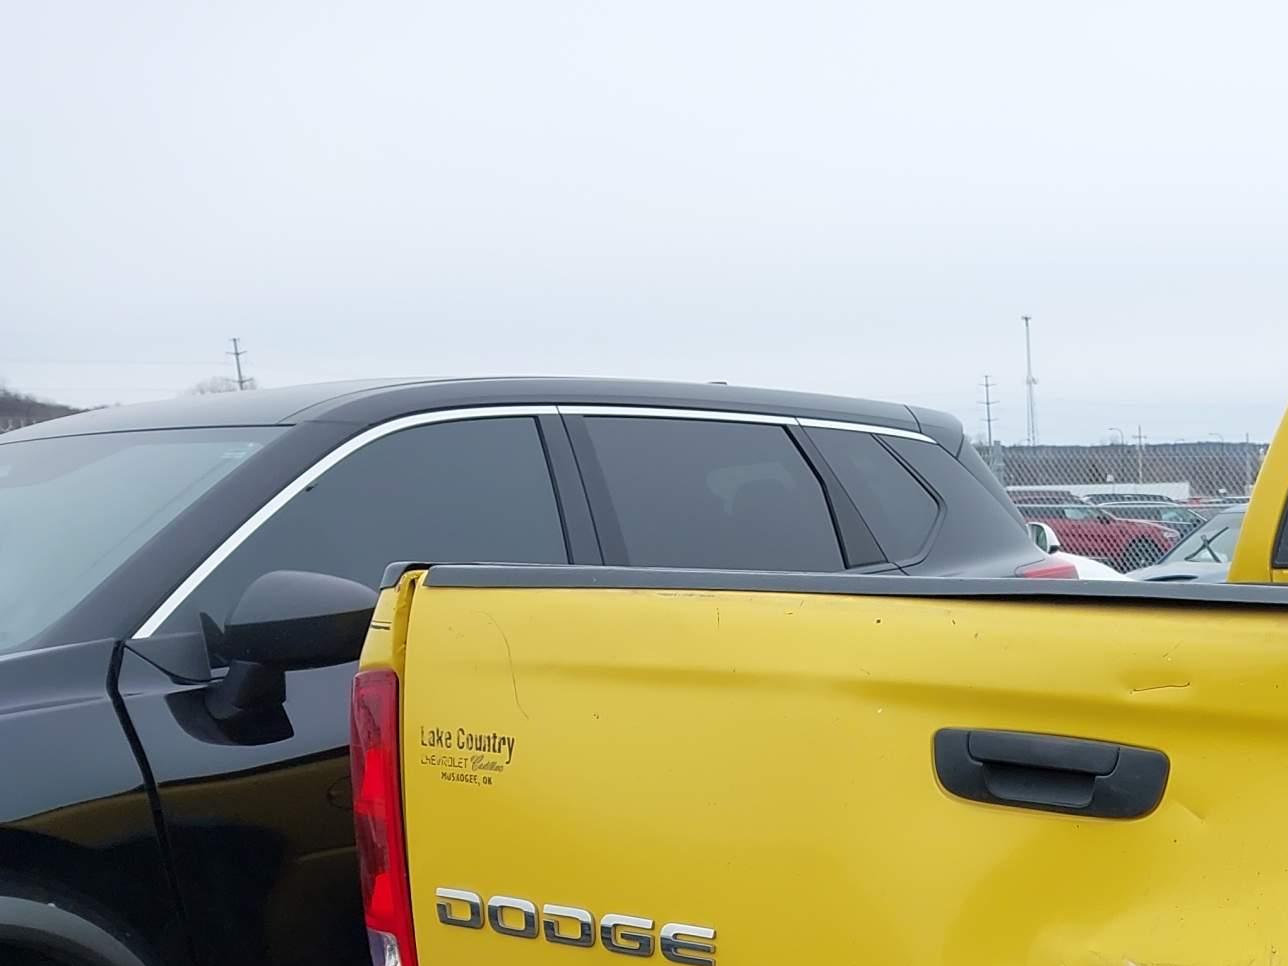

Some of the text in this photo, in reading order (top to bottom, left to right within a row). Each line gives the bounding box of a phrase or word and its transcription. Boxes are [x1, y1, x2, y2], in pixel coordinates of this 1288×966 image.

[420, 726, 515, 765] Lake Country
[440, 771, 493, 786] MUSKOGEE, OK
